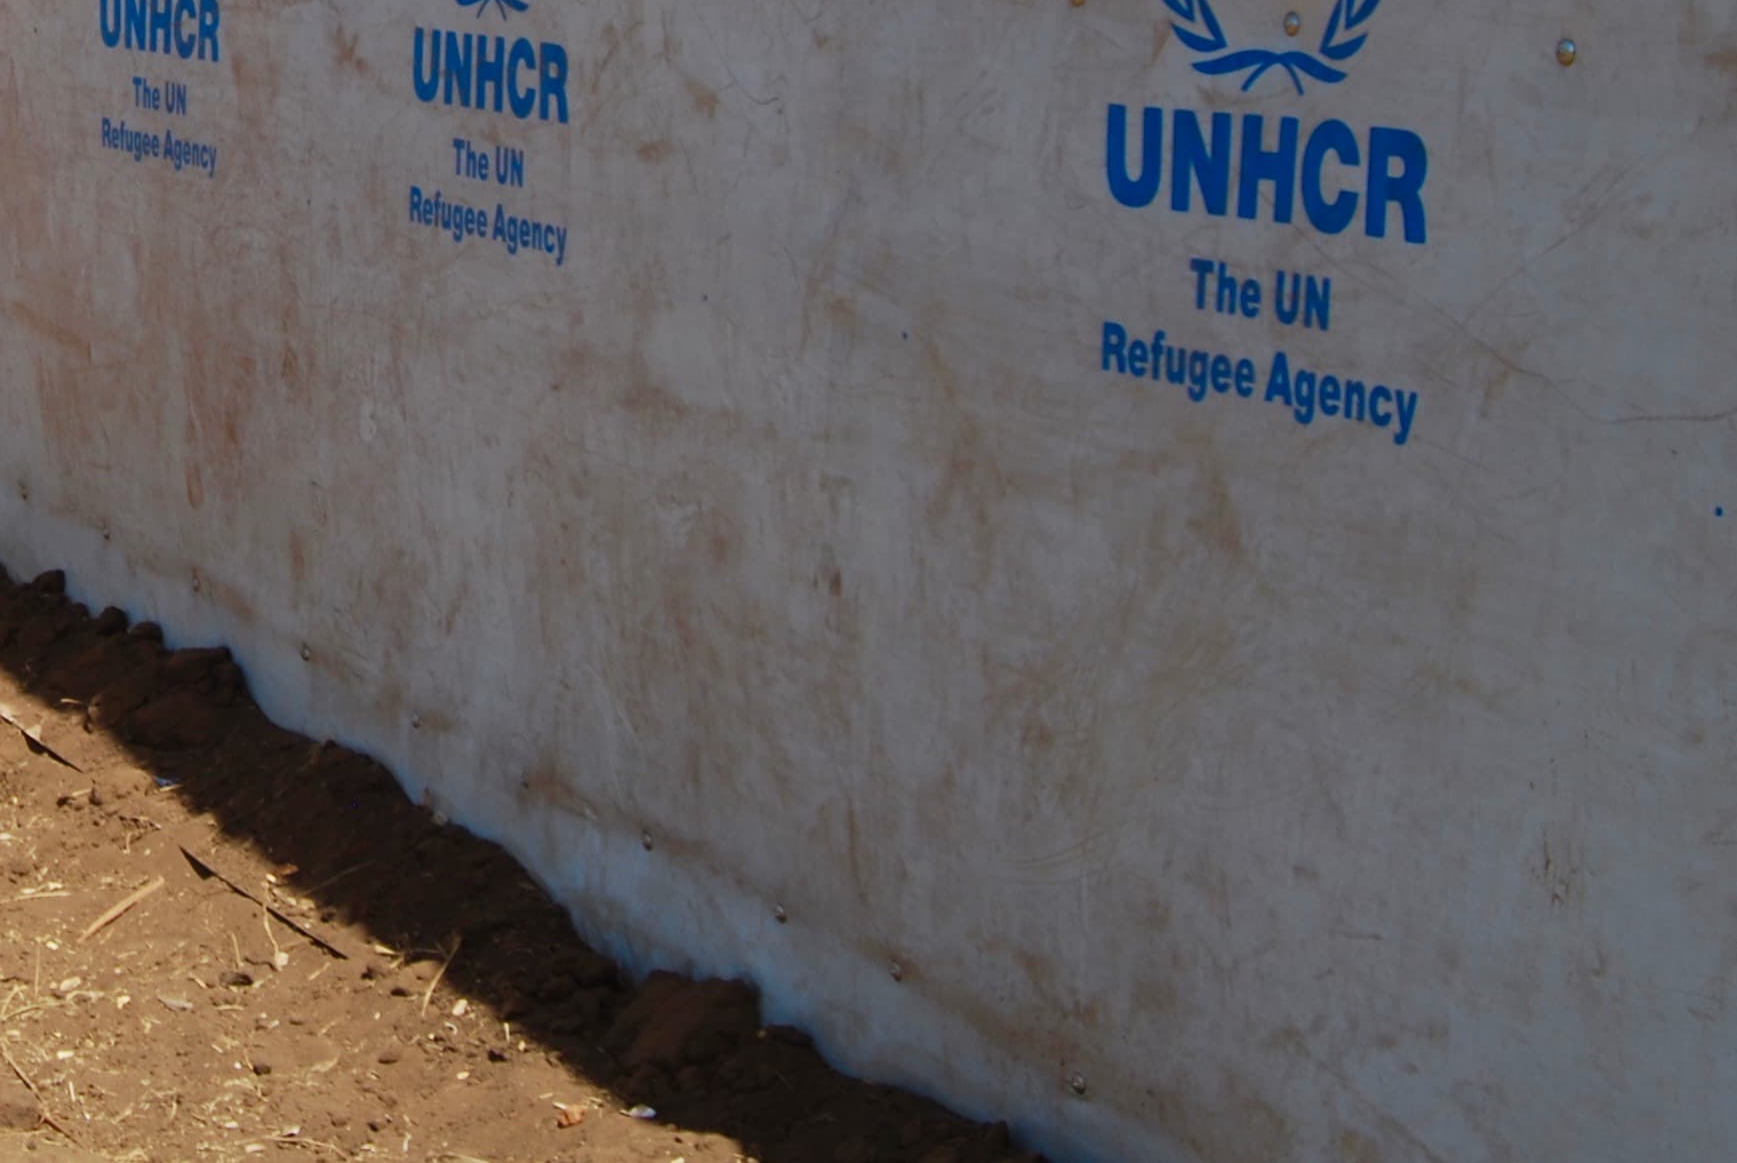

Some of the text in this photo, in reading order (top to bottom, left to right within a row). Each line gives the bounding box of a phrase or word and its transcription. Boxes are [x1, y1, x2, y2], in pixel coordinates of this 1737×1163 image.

[132, 77, 188, 115] The UN
[413, 26, 569, 124] UNHCR
[101, 118, 217, 178] Refugee Agency
[452, 138, 525, 188] The UN
[1105, 103, 1428, 245] UNHCR
[409, 186, 568, 266] Refugee Agency
[1189, 258, 1332, 330] The UN
[1101, 321, 1418, 445] Refugee Agency
